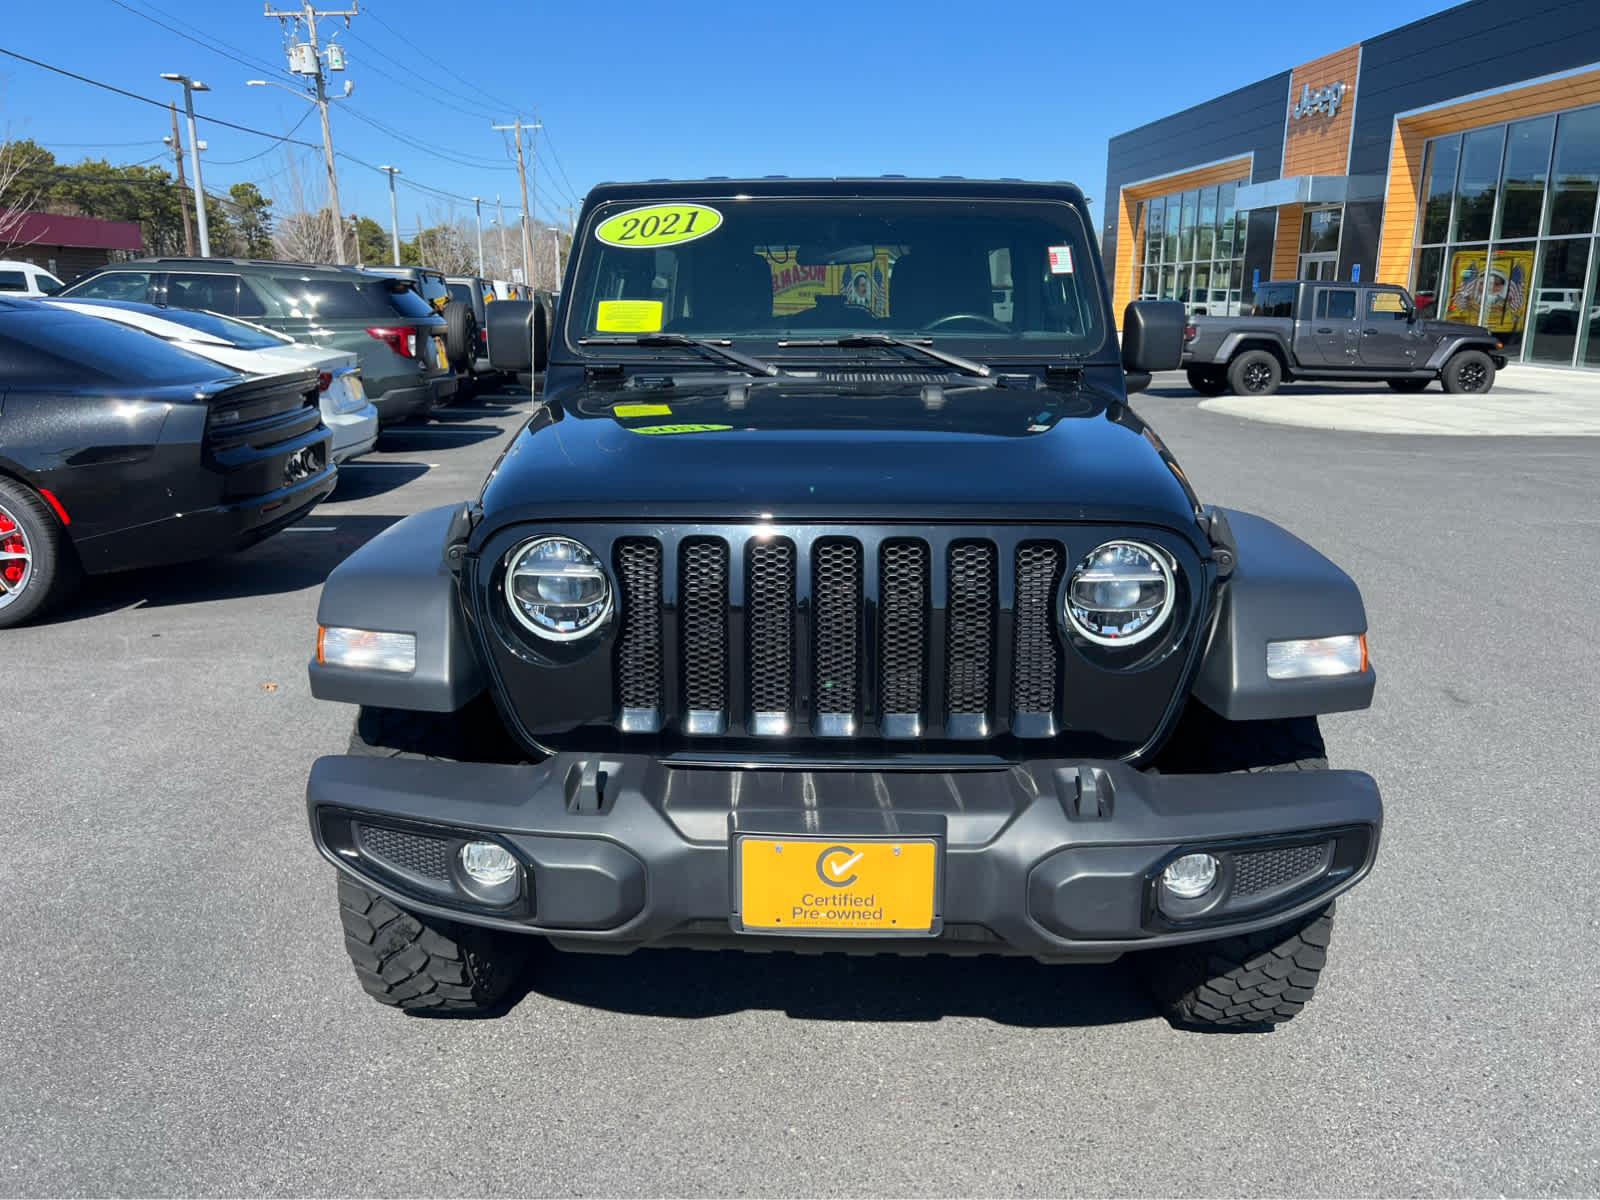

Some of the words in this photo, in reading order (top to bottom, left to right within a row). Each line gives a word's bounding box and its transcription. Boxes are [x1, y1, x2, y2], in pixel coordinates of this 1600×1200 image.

[1293, 81, 1345, 119] Jeep
[618, 211, 699, 241] 2021
[802, 894, 875, 907] Certified
